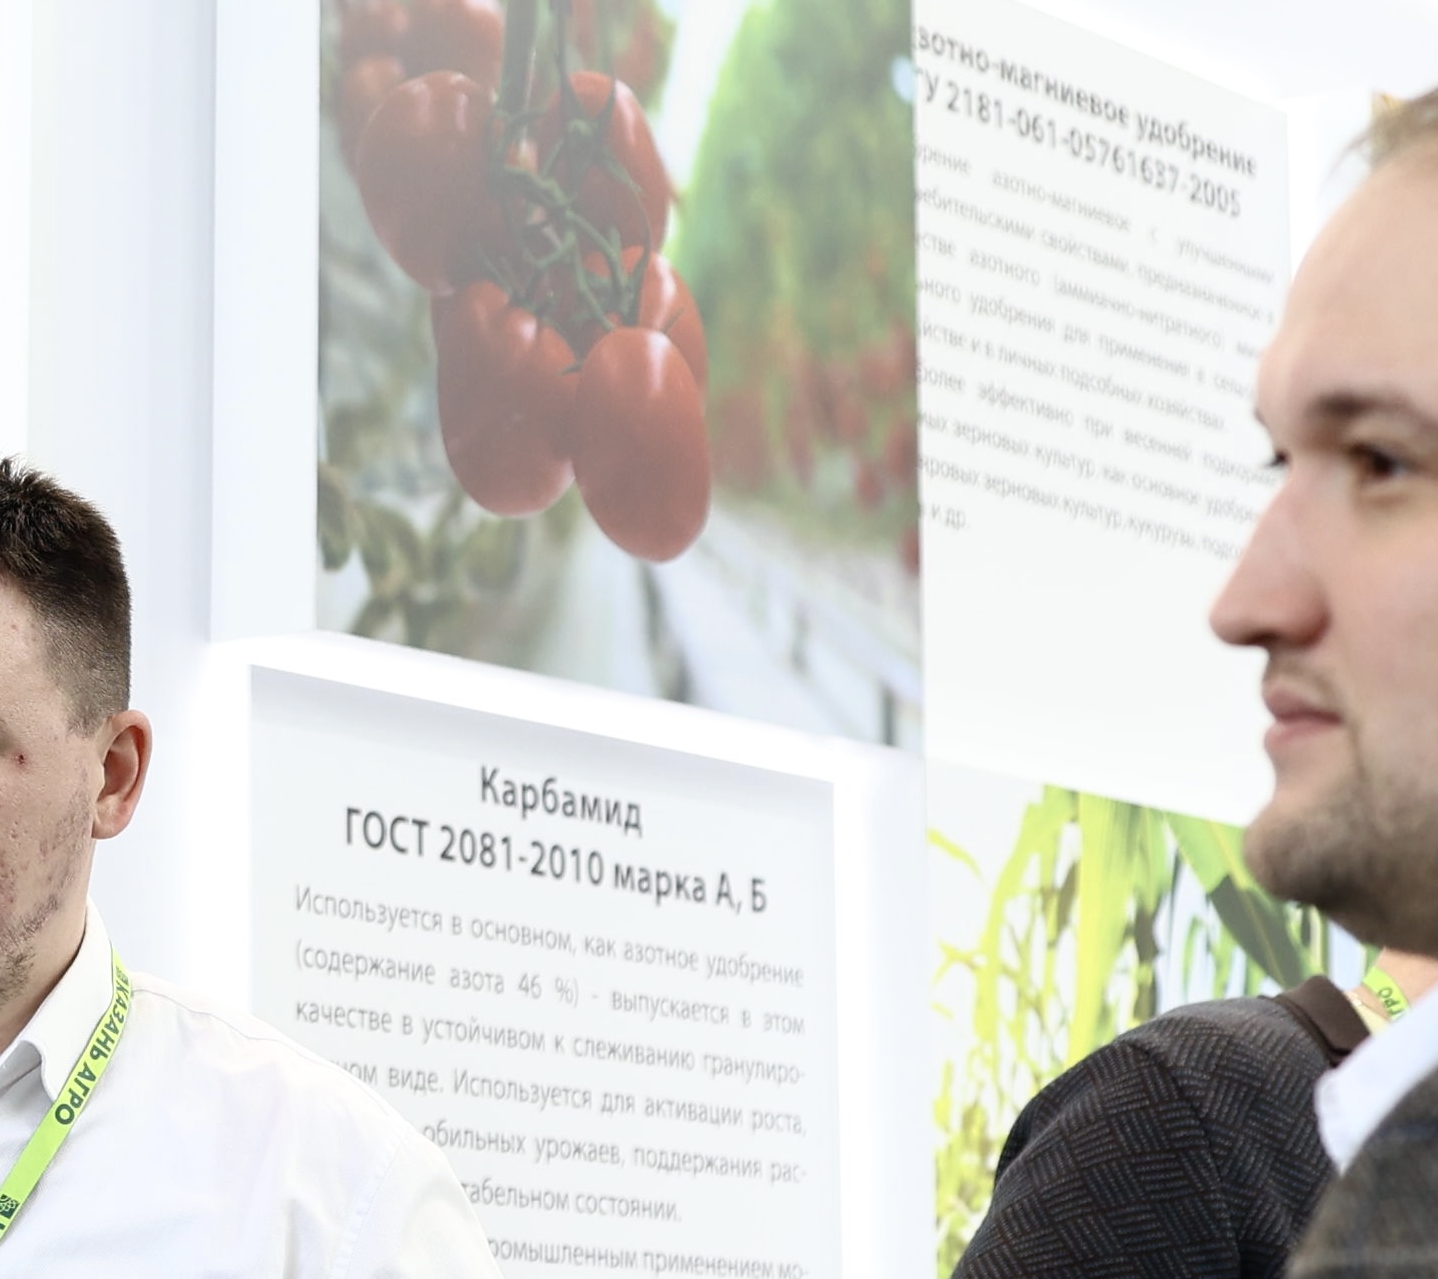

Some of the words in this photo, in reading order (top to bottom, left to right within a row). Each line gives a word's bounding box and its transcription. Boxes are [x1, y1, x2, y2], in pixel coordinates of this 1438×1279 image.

[913, 25, 1130, 129] зотно-магниевое
[480, 765, 643, 838] Карбамид
[346, 806, 431, 857] ГОСТ
[439, 823, 605, 887] 2081-2010
[613, 862, 707, 907] марка
[714, 871, 742, 915] А,
[750, 876, 767, 914] Б
[295, 883, 443, 933] Используется
[450, 914, 463, 937] в
[469, 917, 577, 957] основном,
[583, 935, 617, 958] как
[622, 940, 699, 973] азотное
[705, 952, 802, 988] удобрение
[89, 983, 130, 1060] КАЗАНЬ
[295, 938, 436, 986] (содержание
[448, 966, 505, 995] азота
[517, 972, 543, 1000] 46
[553, 974, 580, 1009] %)
[610, 989, 730, 1025] выпускается
[740, 1008, 752, 1029] в
[762, 1011, 806, 1035] этом
[295, 1001, 393, 1034] качестве
[401, 1013, 414, 1036] в
[421, 1015, 546, 1052] устойчивом
[553, 1034, 565, 1054] к
[572, 1036, 696, 1072] слеживанию
[702, 1052, 806, 1088] гранулиро-
[55, 1061, 97, 1126] АГРО
[386, 1065, 444, 1097] виде.
[451, 1067, 592, 1113] Используется
[599, 1091, 636, 1116] для
[643, 1096, 743, 1128] активации
[749, 1108, 807, 1138] роста,
[534, 1135, 626, 1169] урожаев,
[633, 1145, 759, 1180] поддержания
[770, 1159, 808, 1187] рас-
[574, 1192, 682, 1222] состоянии.
